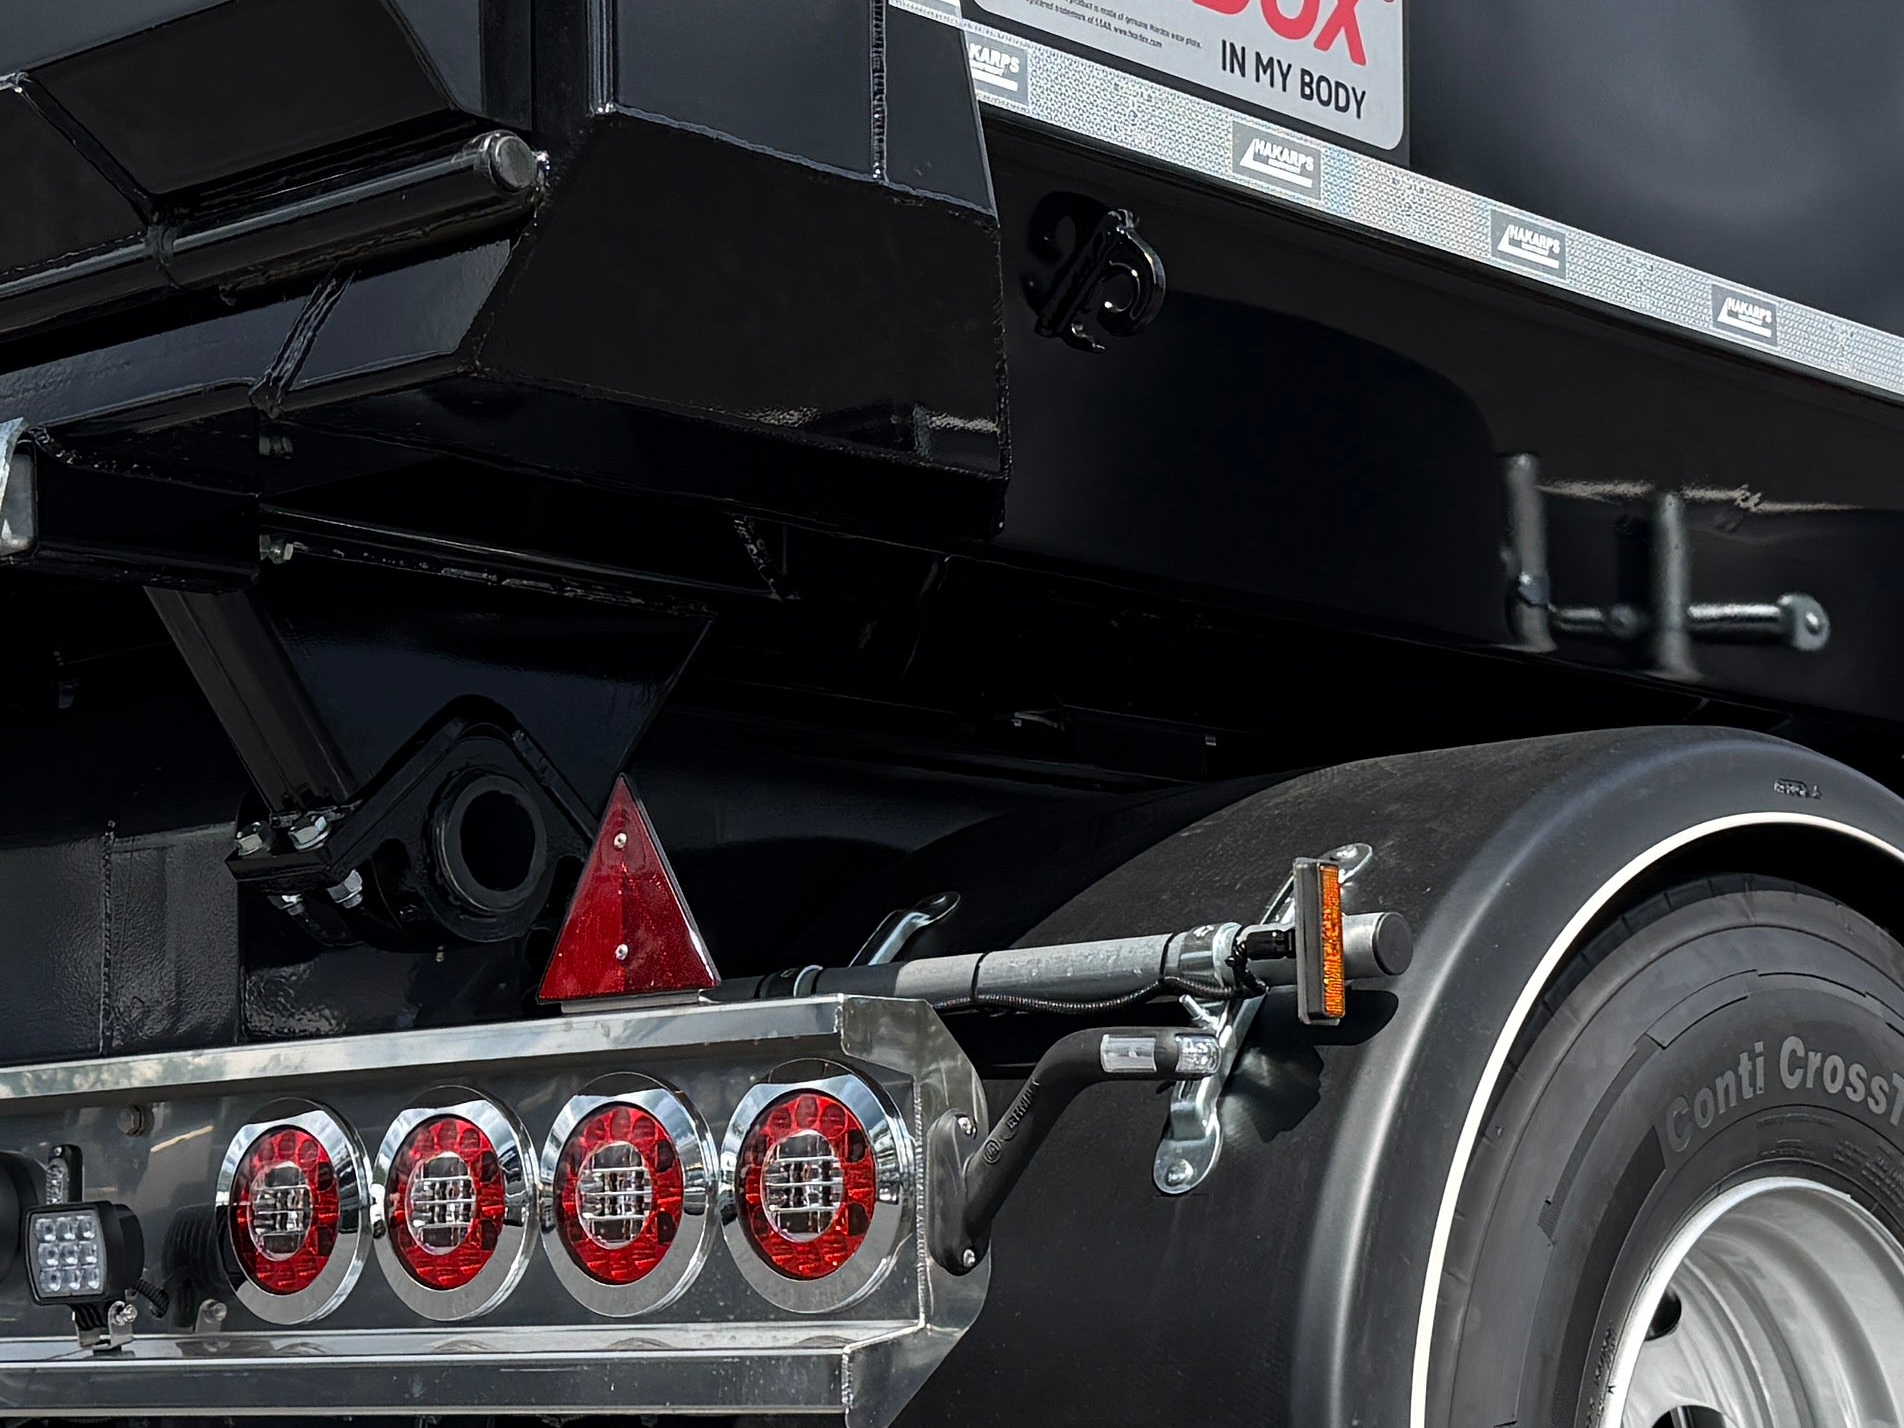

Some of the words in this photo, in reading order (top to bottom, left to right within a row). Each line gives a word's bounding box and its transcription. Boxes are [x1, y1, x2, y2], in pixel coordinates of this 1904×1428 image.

[1221, 39, 1246, 79] IN
[1255, 51, 1292, 93] MY
[1300, 67, 1367, 121] BODY
[1252, 137, 1314, 173] HAKARPS
[1505, 223, 1562, 255] HAKARPS
[1665, 1041, 1765, 1153] Conti
